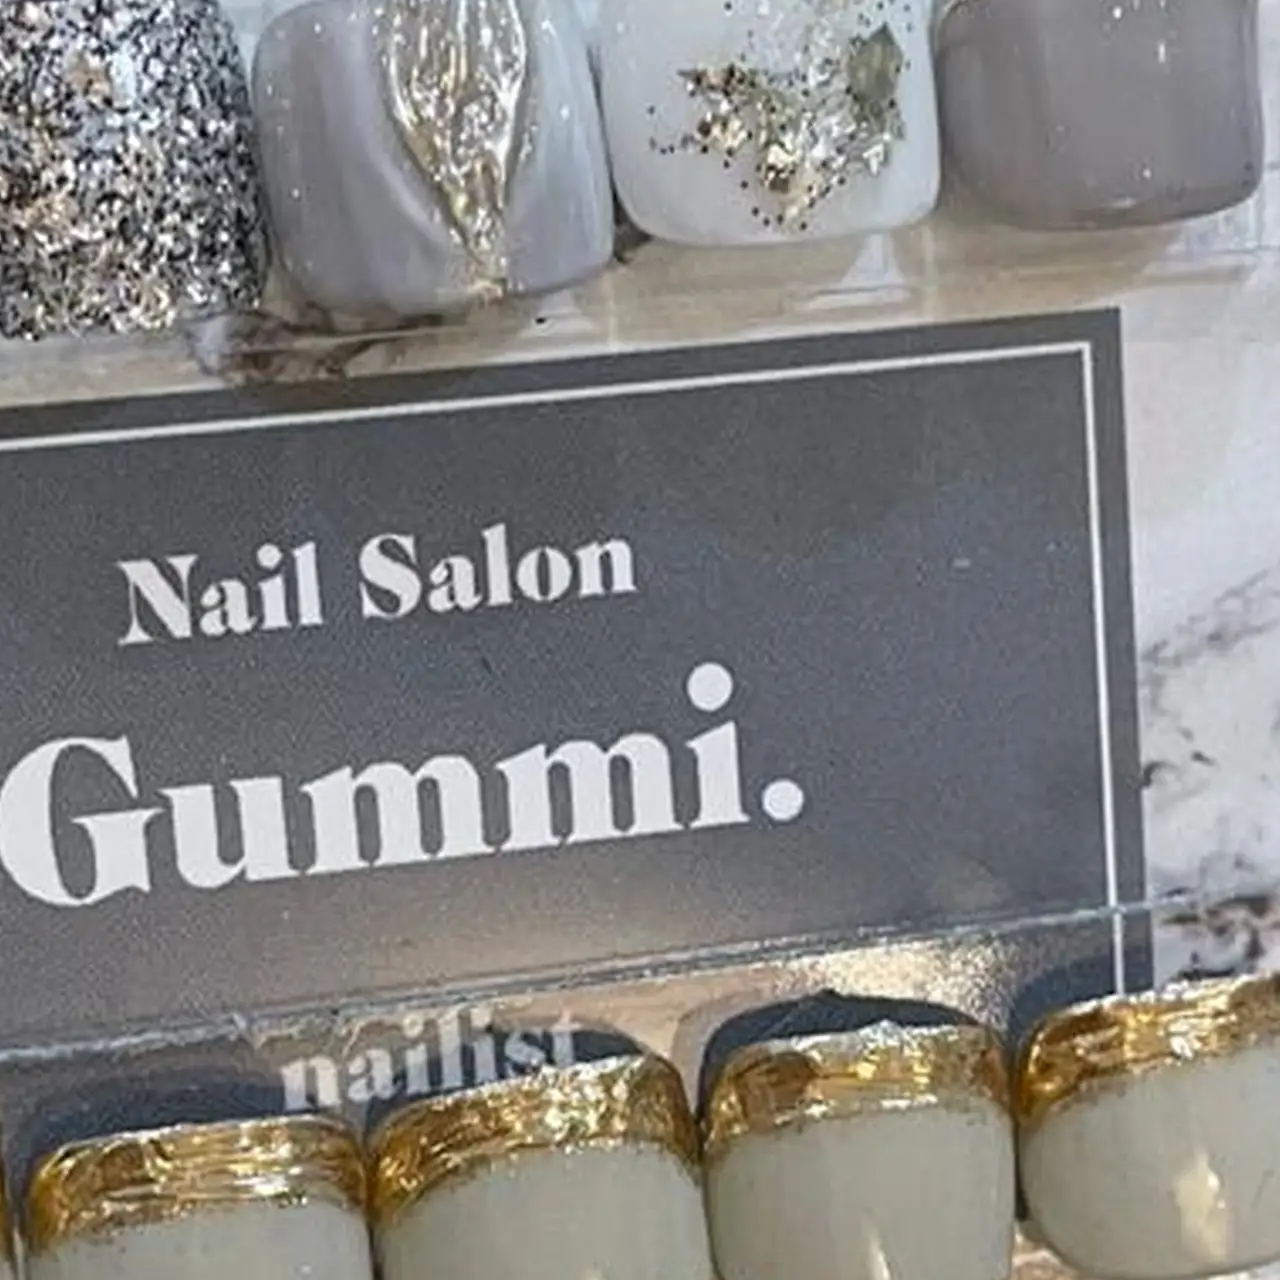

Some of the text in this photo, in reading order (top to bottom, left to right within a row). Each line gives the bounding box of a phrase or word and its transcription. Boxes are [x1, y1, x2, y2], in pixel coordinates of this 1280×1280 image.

[116, 522, 638, 646] Nail Salon
[279, 1005, 582, 1111] nailist
